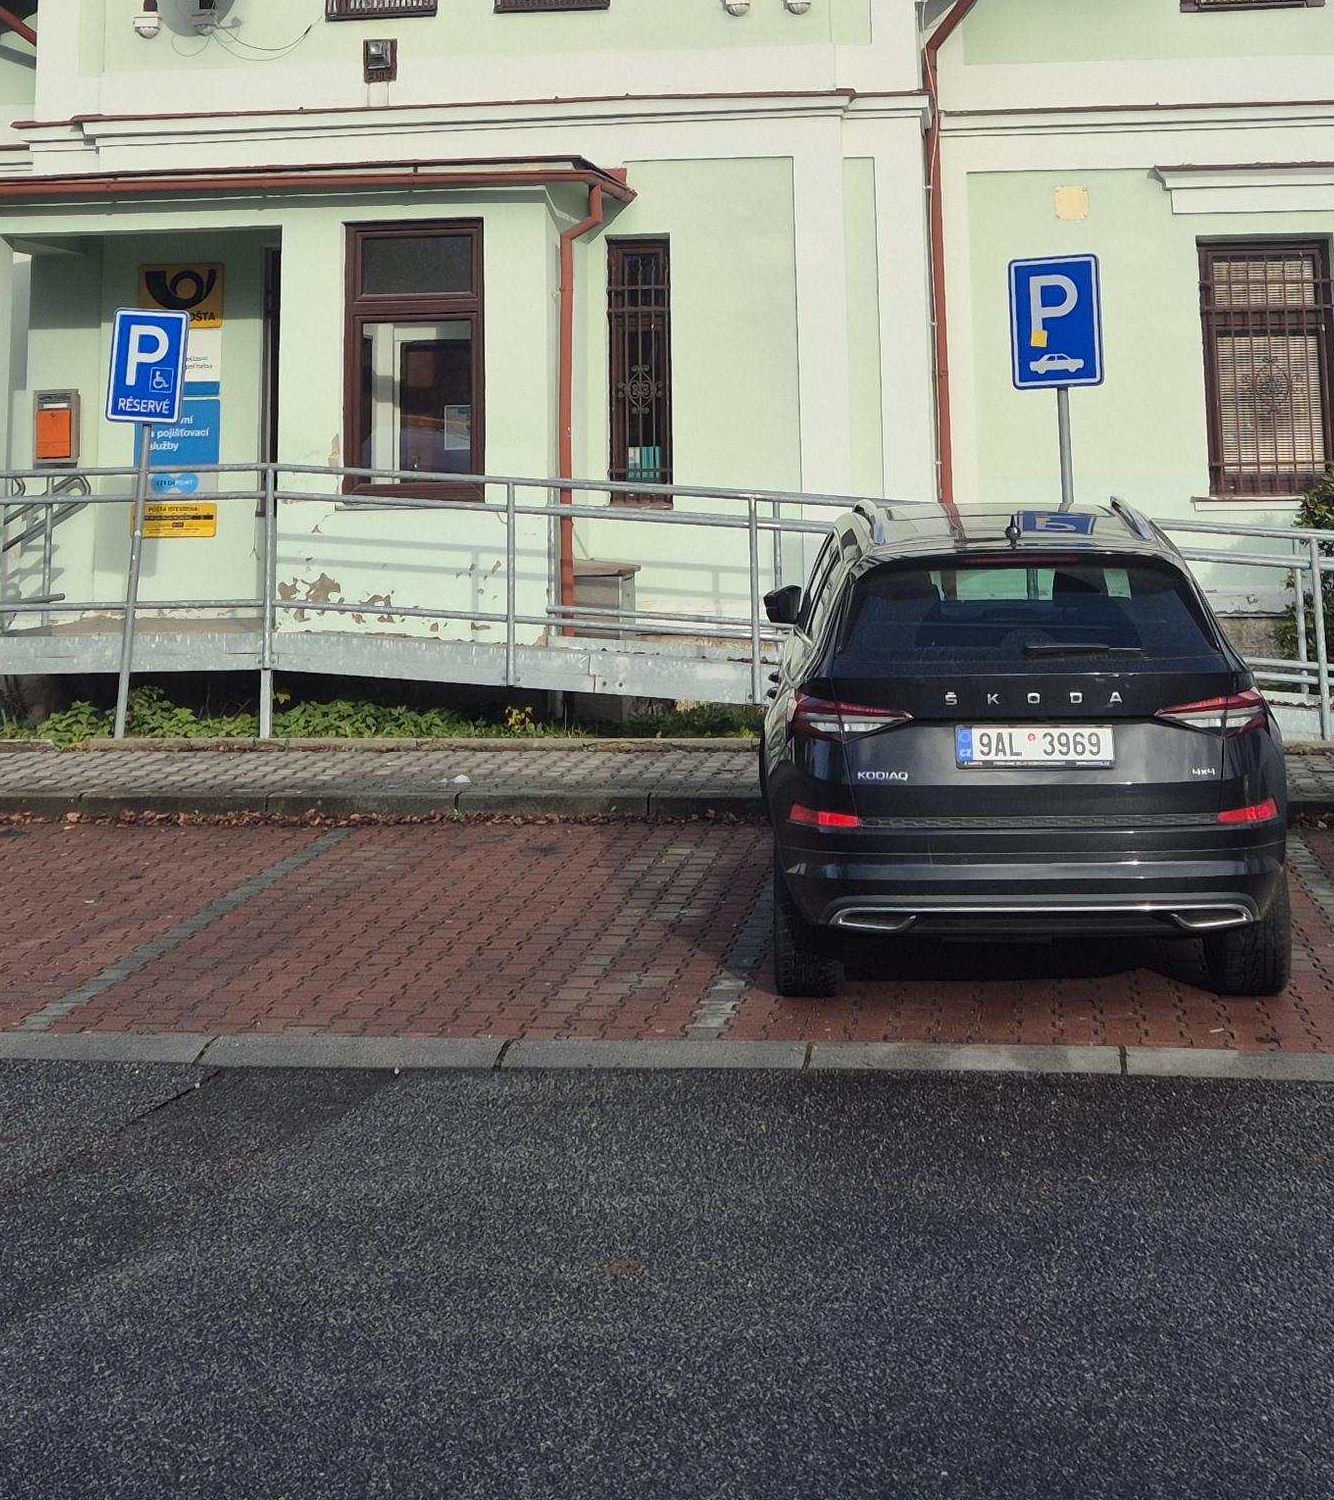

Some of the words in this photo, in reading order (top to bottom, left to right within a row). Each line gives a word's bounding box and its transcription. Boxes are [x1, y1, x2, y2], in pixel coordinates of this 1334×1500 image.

[189, 310, 215, 322] OŠTA
[1029, 274, 1078, 346] P
[125, 324, 169, 386] P
[117, 395, 170, 414] RÉSERVÉ
[944, 691, 1124, 706] ŠKODA
[960, 749, 972, 757] CZ
[979, 732, 1023, 757] 9AL
[1042, 732, 1101, 757] 3969
[857, 771, 909, 782] KODIAQ
